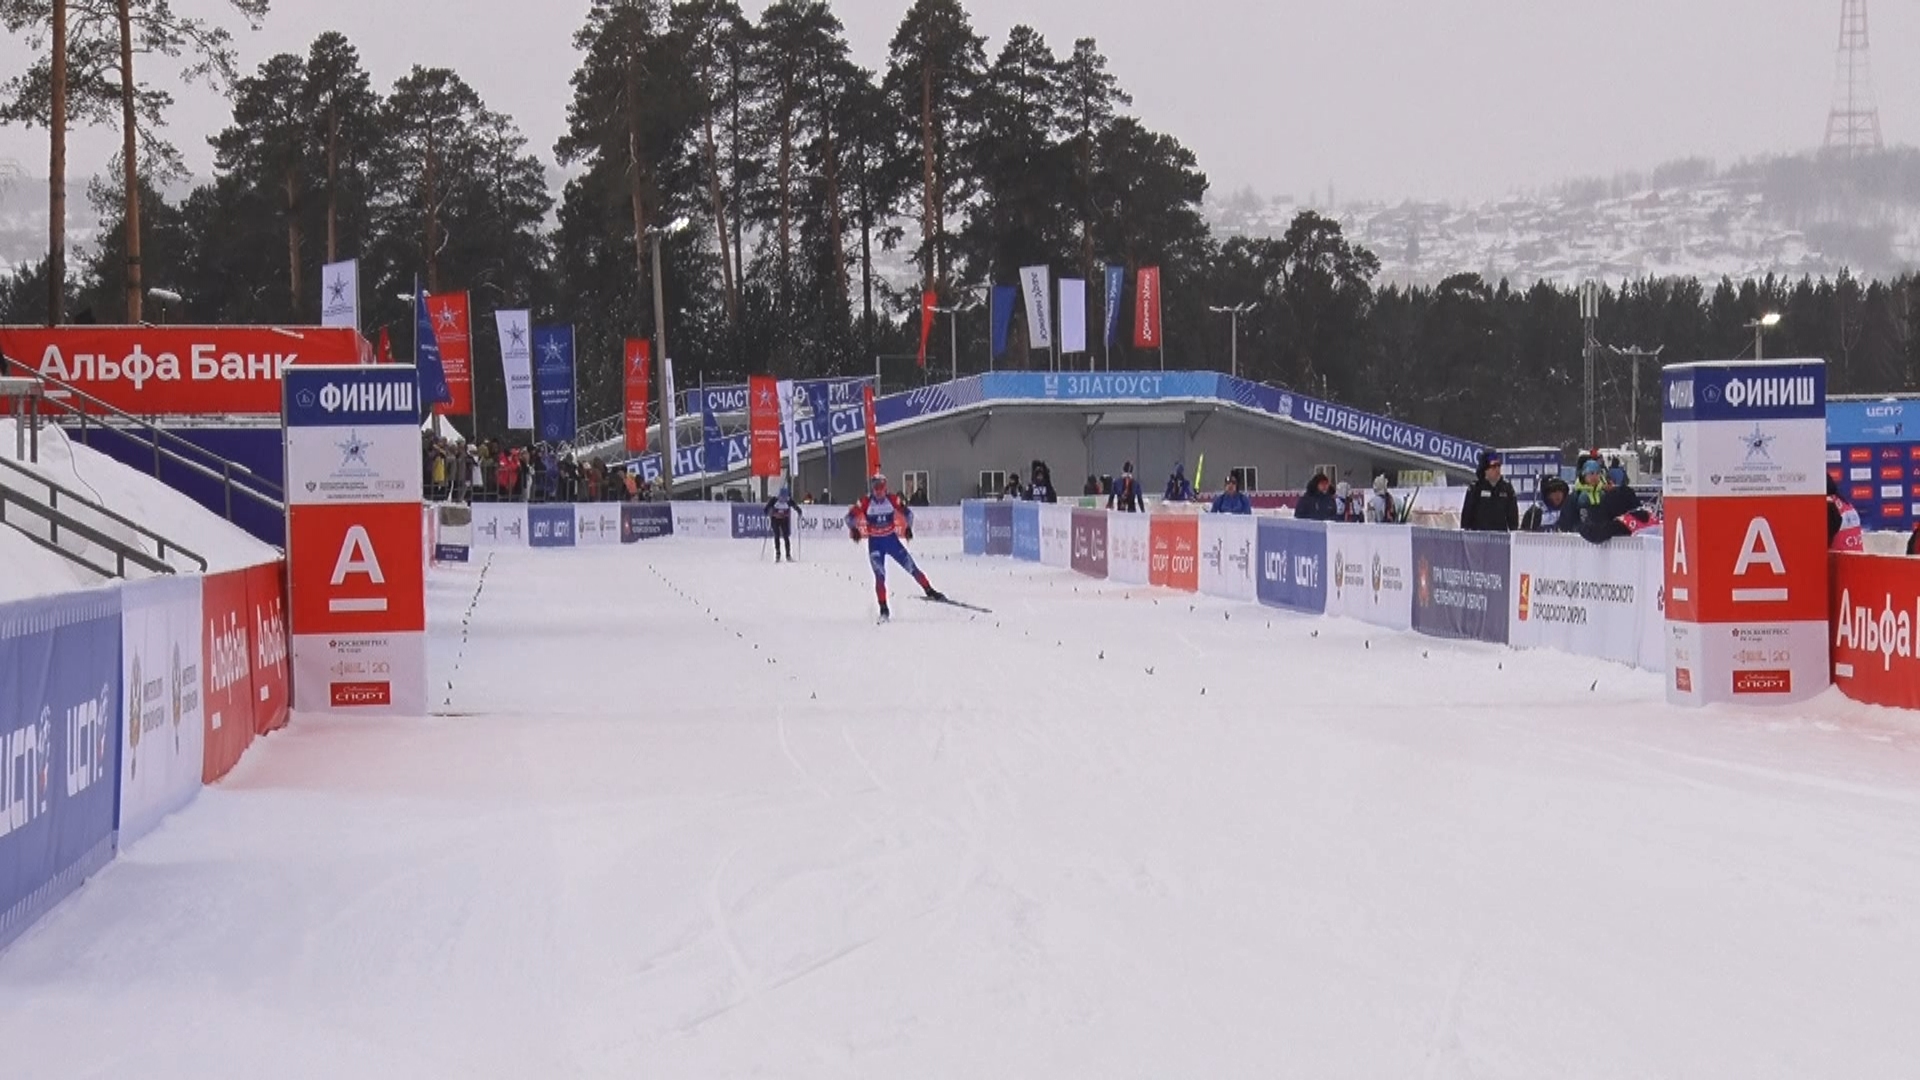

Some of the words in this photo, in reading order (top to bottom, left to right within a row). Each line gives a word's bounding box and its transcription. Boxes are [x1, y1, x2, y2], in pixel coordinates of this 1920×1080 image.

[39, 344, 181, 390] Альфа
[191, 344, 297, 380] Банк
[320, 382, 413, 412] ФИНИШ
[1068, 376, 1163, 395] ЗЛАТОУСТ
[1725, 377, 1815, 407] ФИНИШ
[1304, 400, 1425, 450] ЧЕЛЯБИНСКАЯ
[1429, 436, 1484, 467] ОБЛАС
[748, 516, 771, 531] ЗЛАТО
[1172, 555, 1194, 573] СПОРТ
[1836, 588, 1910, 671] Альфа
[1737, 680, 1786, 688] СПОРТ
[335, 692, 386, 701] СПОРТ
